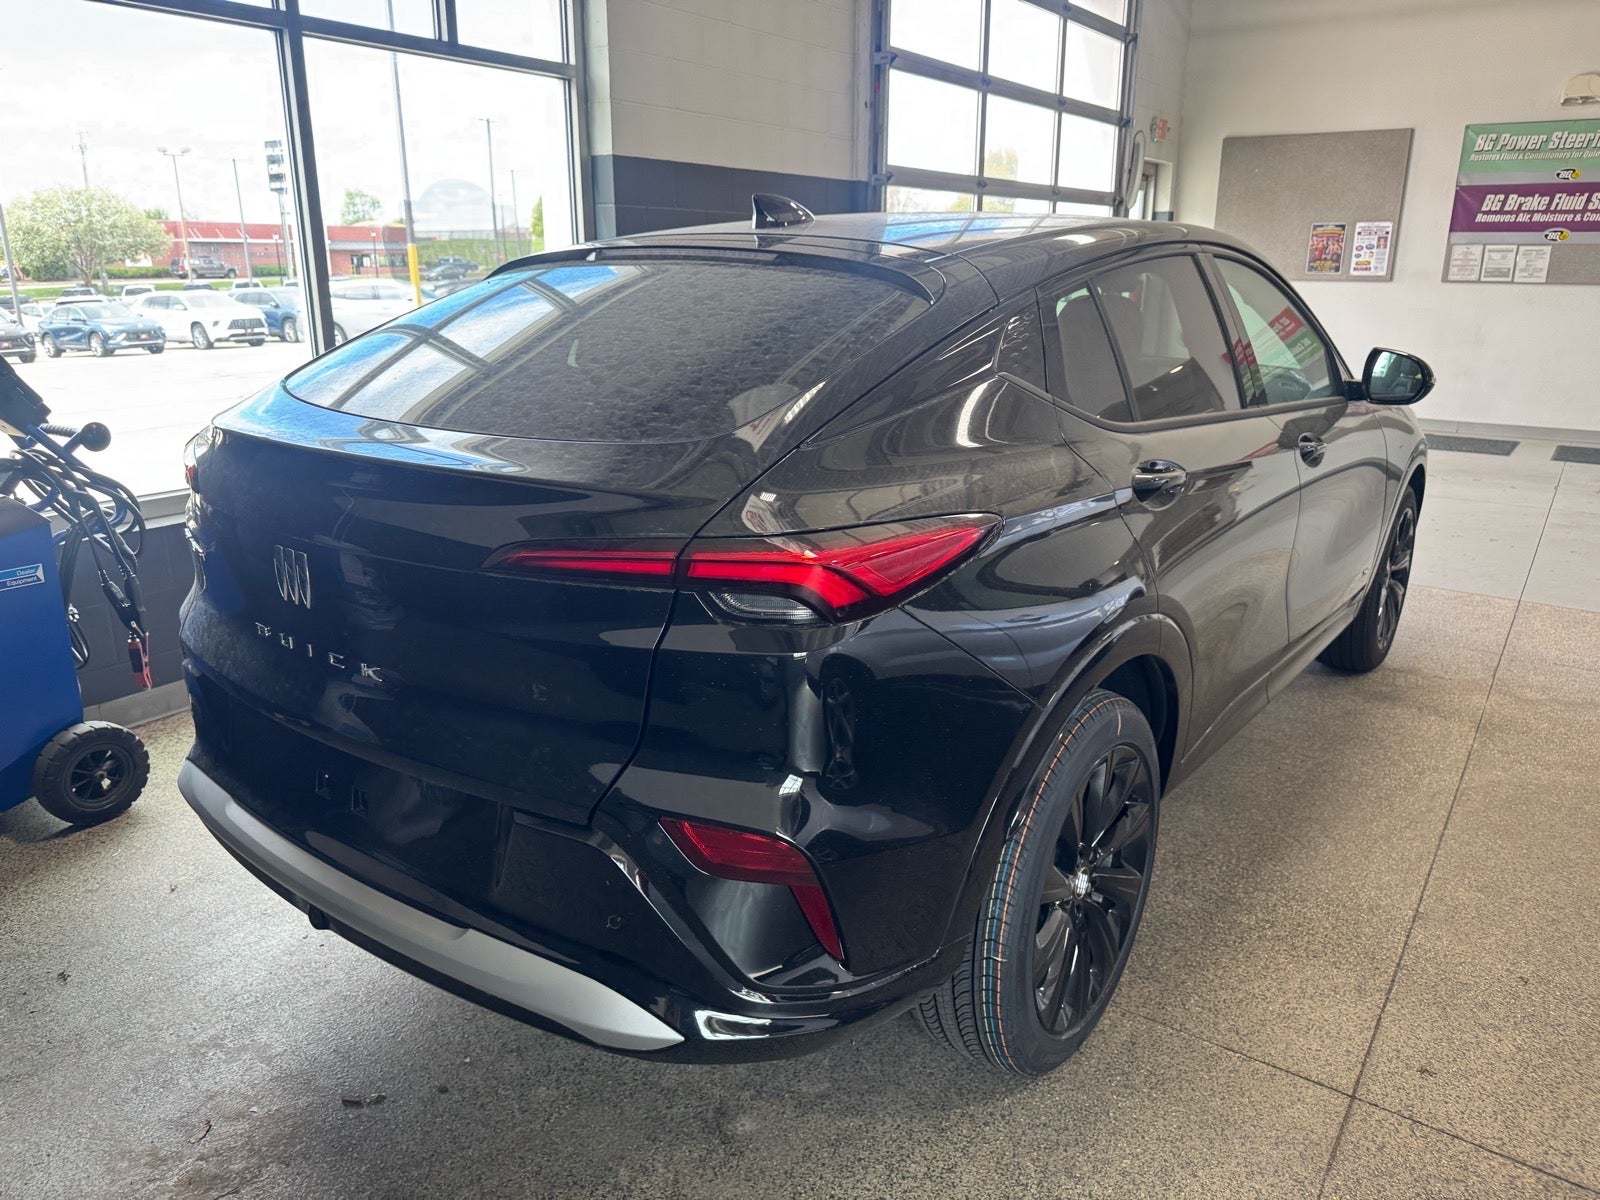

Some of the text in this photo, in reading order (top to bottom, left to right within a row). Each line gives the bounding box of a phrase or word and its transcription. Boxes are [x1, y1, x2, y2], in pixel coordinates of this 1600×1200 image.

[1474, 130, 1600, 151] BG Power Steeri
[1500, 152, 1518, 160] Fluid
[1523, 151, 1571, 160] Conditioners
[1571, 151, 1583, 159] for
[1481, 192, 1600, 212] BG Brake Fluid S
[1475, 213, 1516, 222] Removes
[1516, 213, 1531, 223] Air,
[1531, 212, 1574, 222] Moisture
[1574, 213, 1582, 222] &
[7, 576, 38, 586] Equipment
